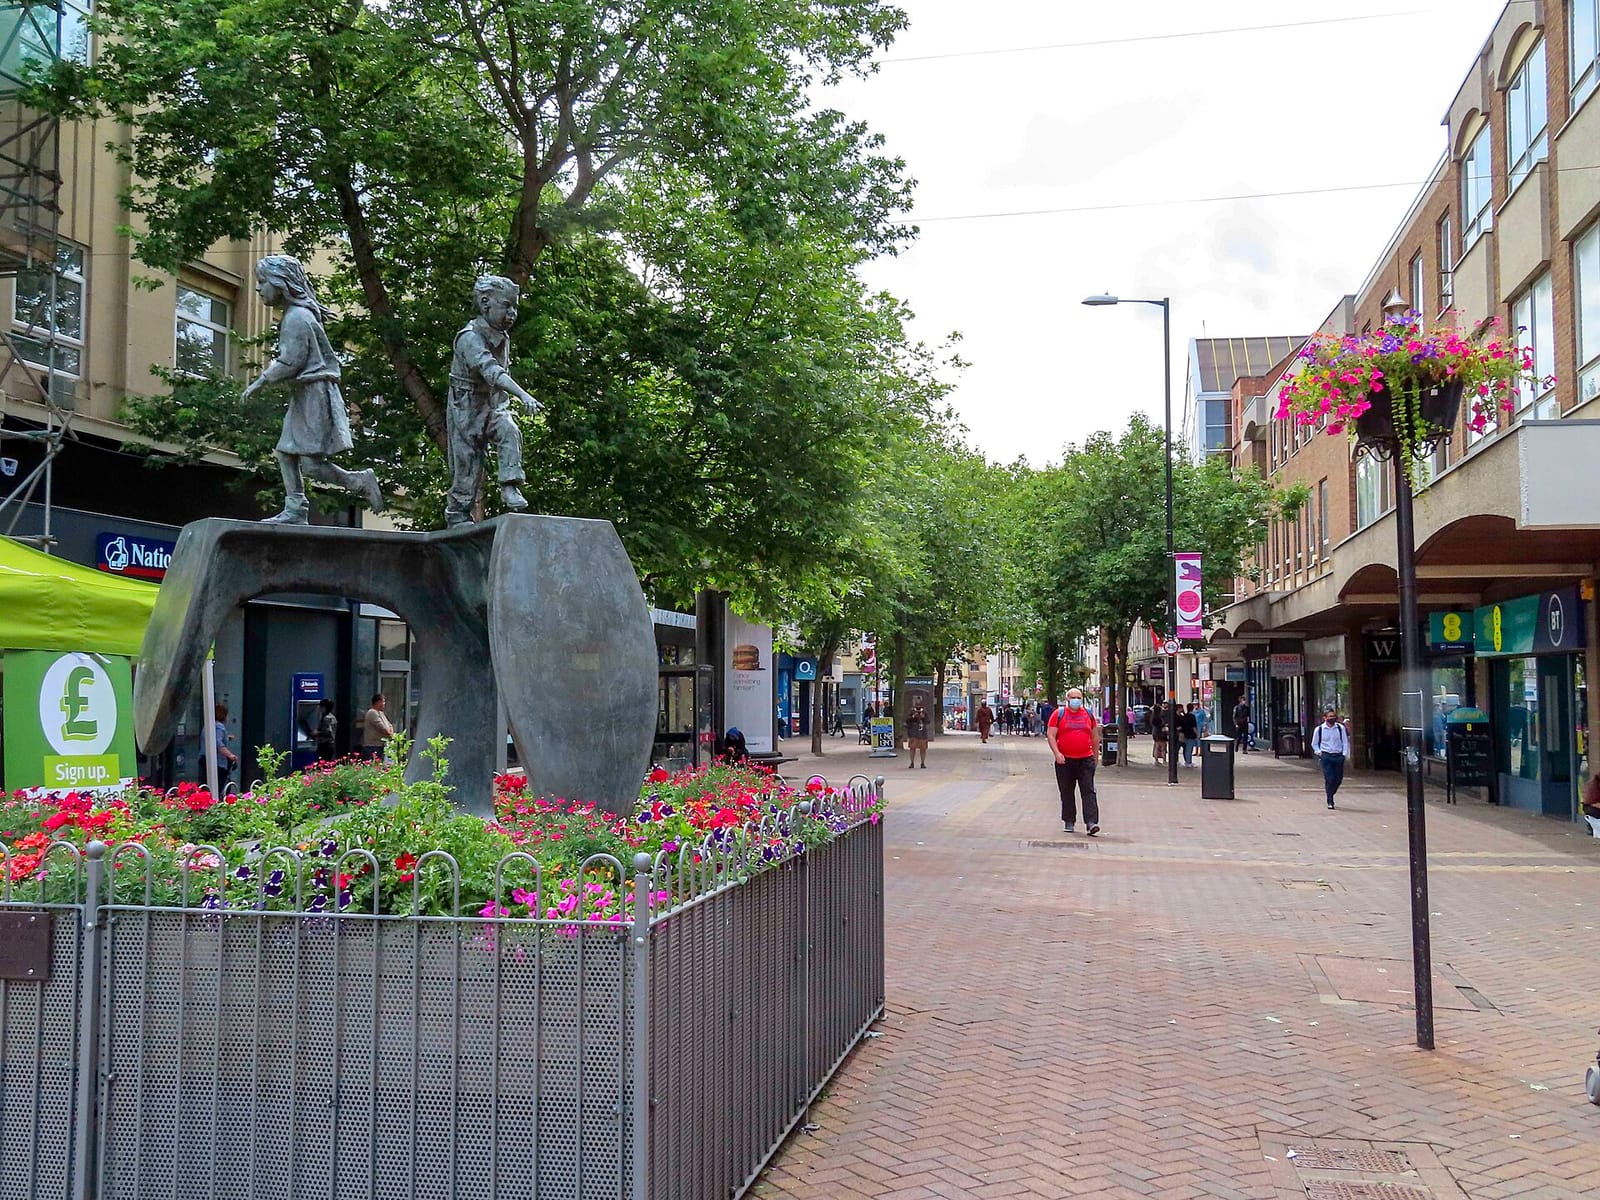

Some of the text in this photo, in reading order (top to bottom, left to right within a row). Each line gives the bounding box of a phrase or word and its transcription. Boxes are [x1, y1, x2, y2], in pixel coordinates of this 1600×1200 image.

[1551, 610, 1560, 630] BT
[1371, 640, 1396, 657] W
[55, 763, 110, 785] Sign up.
